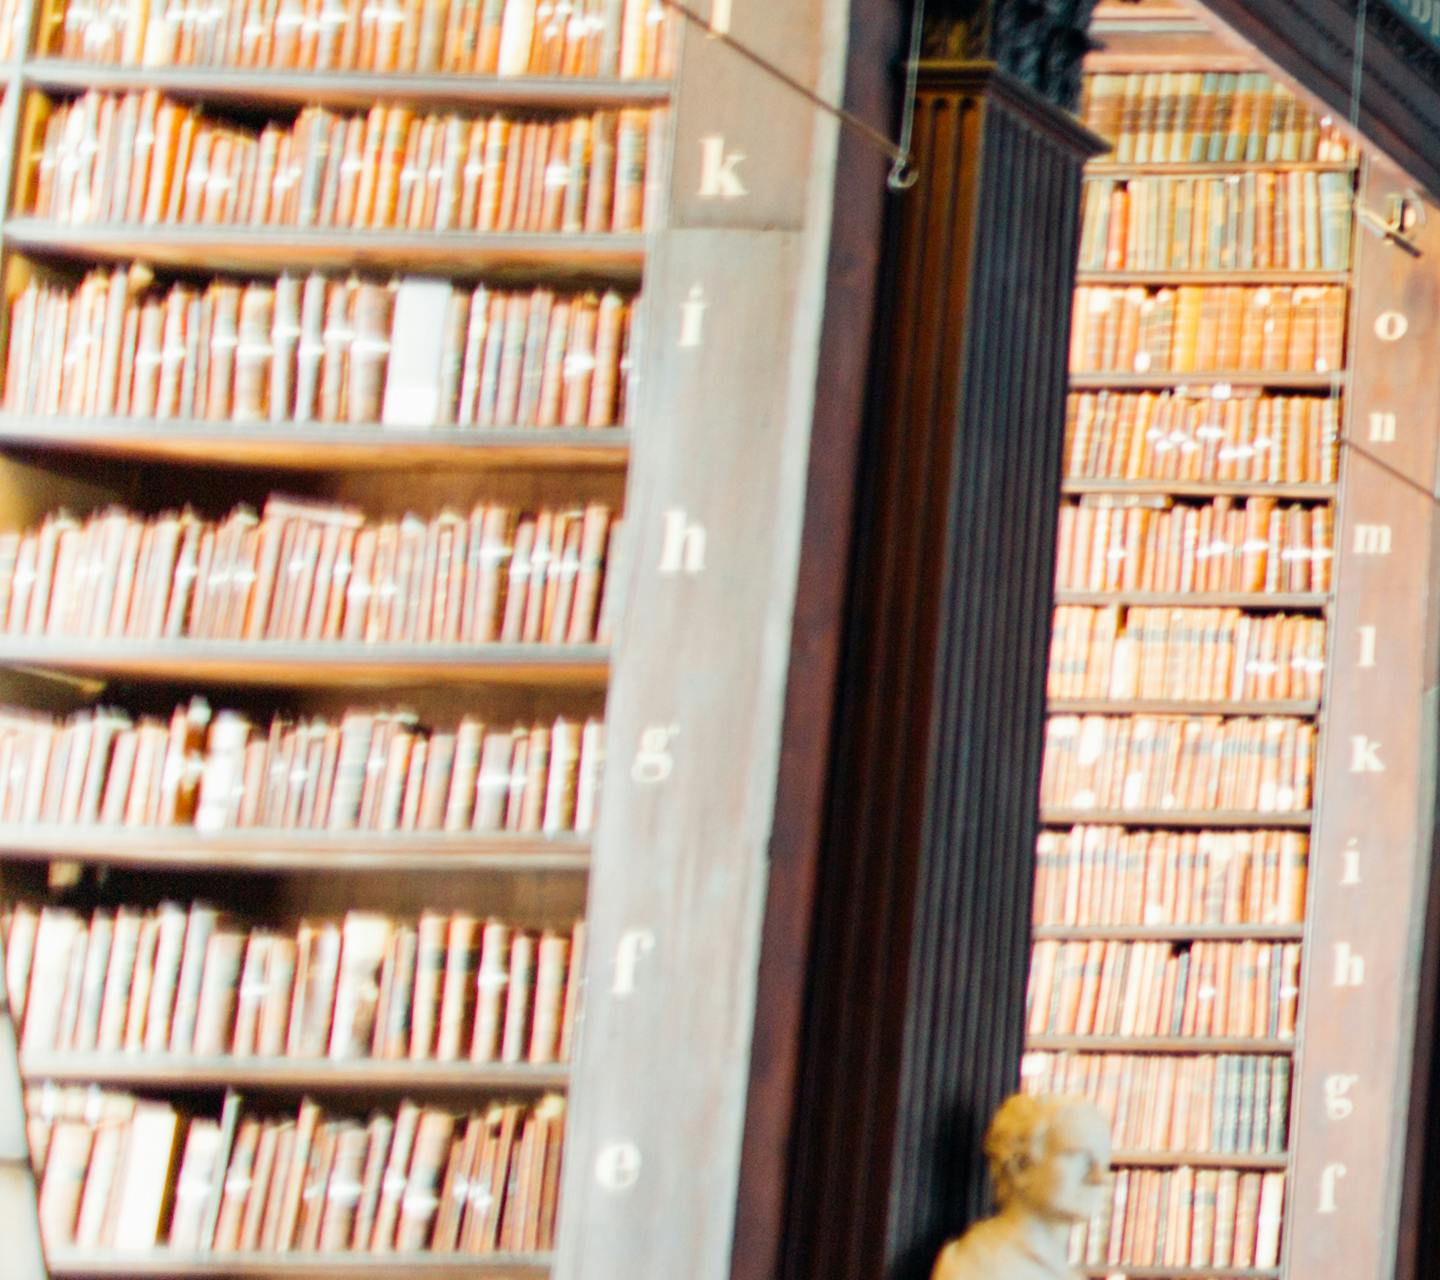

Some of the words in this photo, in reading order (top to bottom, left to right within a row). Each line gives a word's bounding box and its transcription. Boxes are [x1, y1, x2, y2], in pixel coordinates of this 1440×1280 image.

[699, 137, 747, 197] k
[680, 285, 705, 347] i
[1375, 311, 1408, 340] o
[1369, 411, 1396, 443] n
[659, 510, 706, 572] h
[1353, 523, 1391, 555] m
[1355, 626, 1376, 667] l
[632, 724, 680, 783] g
[1350, 735, 1386, 773] k
[1339, 838, 1360, 884] i
[611, 928, 655, 994] f
[1333, 943, 1364, 987] h
[1325, 1073, 1359, 1119] g
[596, 1142, 641, 1190] e
[1317, 1164, 1347, 1212] f
